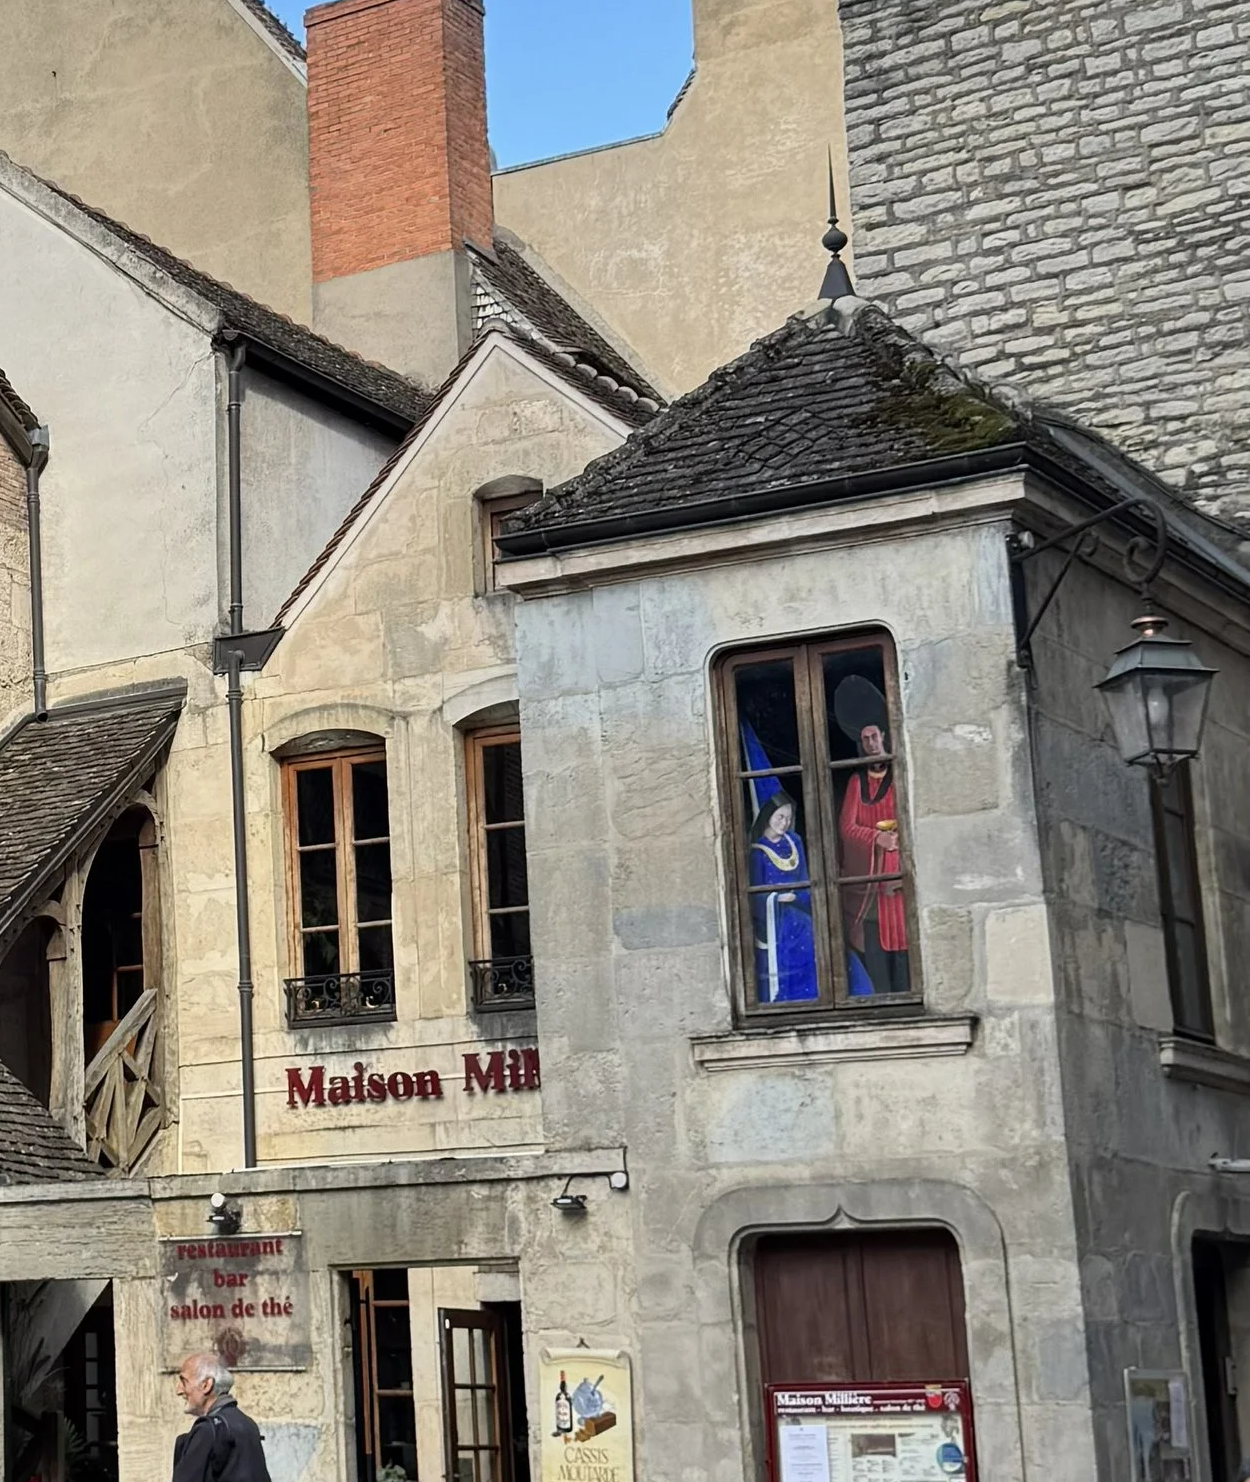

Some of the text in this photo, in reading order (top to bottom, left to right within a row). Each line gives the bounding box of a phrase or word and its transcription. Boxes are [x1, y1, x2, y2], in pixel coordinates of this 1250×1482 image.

[285, 1047, 540, 1106] Maison Mil
[176, 1239, 283, 1260] restaurant
[213, 1270, 248, 1287] bar
[170, 1296, 294, 1320] salon de thé
[776, 1394, 823, 1406] Maison
[564, 1446, 609, 1465] CASSIS
